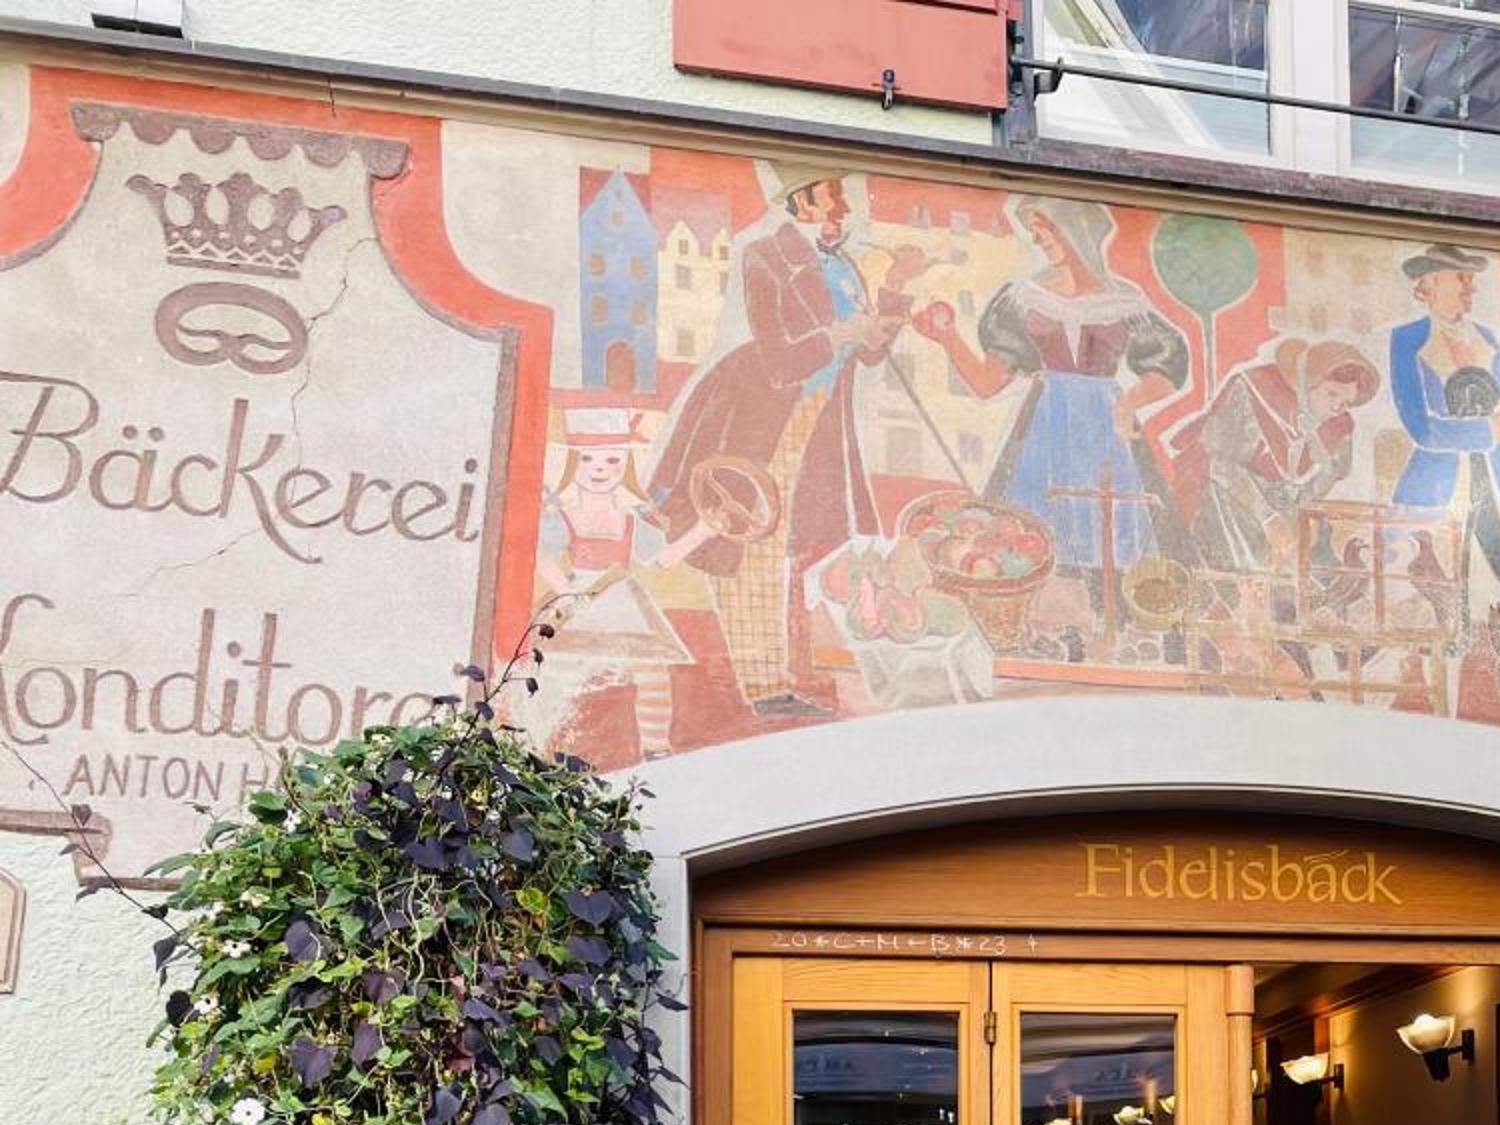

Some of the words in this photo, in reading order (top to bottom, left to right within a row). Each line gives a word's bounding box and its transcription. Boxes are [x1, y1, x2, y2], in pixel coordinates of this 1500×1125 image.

[0, 371, 481, 564] Bäckerei
[0, 593, 465, 746] onditore
[62, 753, 224, 801] ANTON
